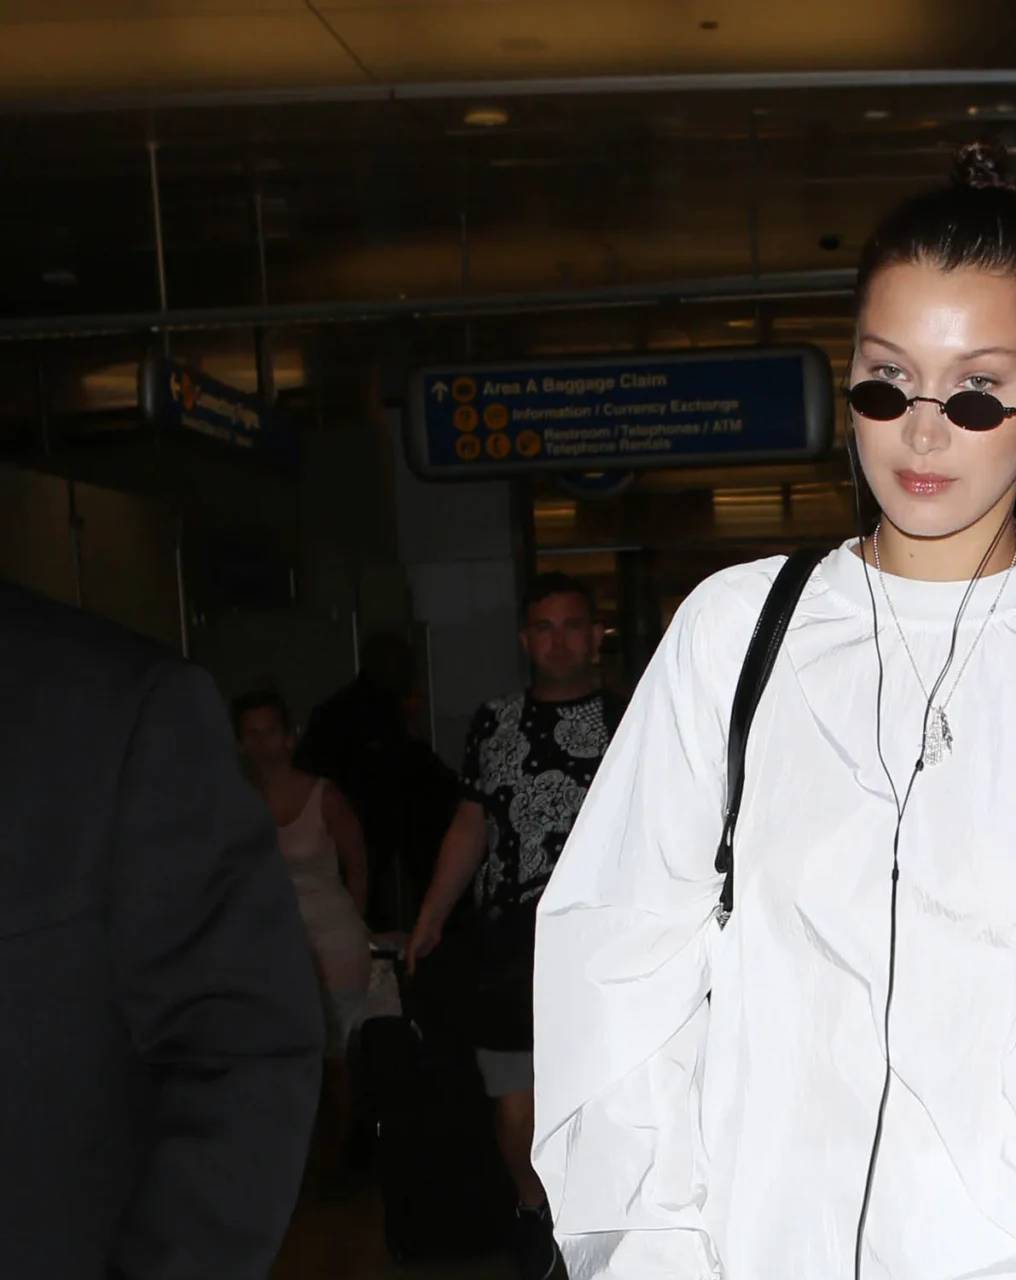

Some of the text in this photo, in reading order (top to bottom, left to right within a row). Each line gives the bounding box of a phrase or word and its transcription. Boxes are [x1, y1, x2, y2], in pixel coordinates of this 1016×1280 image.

[482, 373, 667, 396] Area A Baggage Claim
[512, 405, 592, 421] Information
[602, 401, 666, 416] Currency
[669, 397, 740, 414] Exchange
[620, 423, 701, 440] Telephones
[712, 419, 743, 433] ATM
